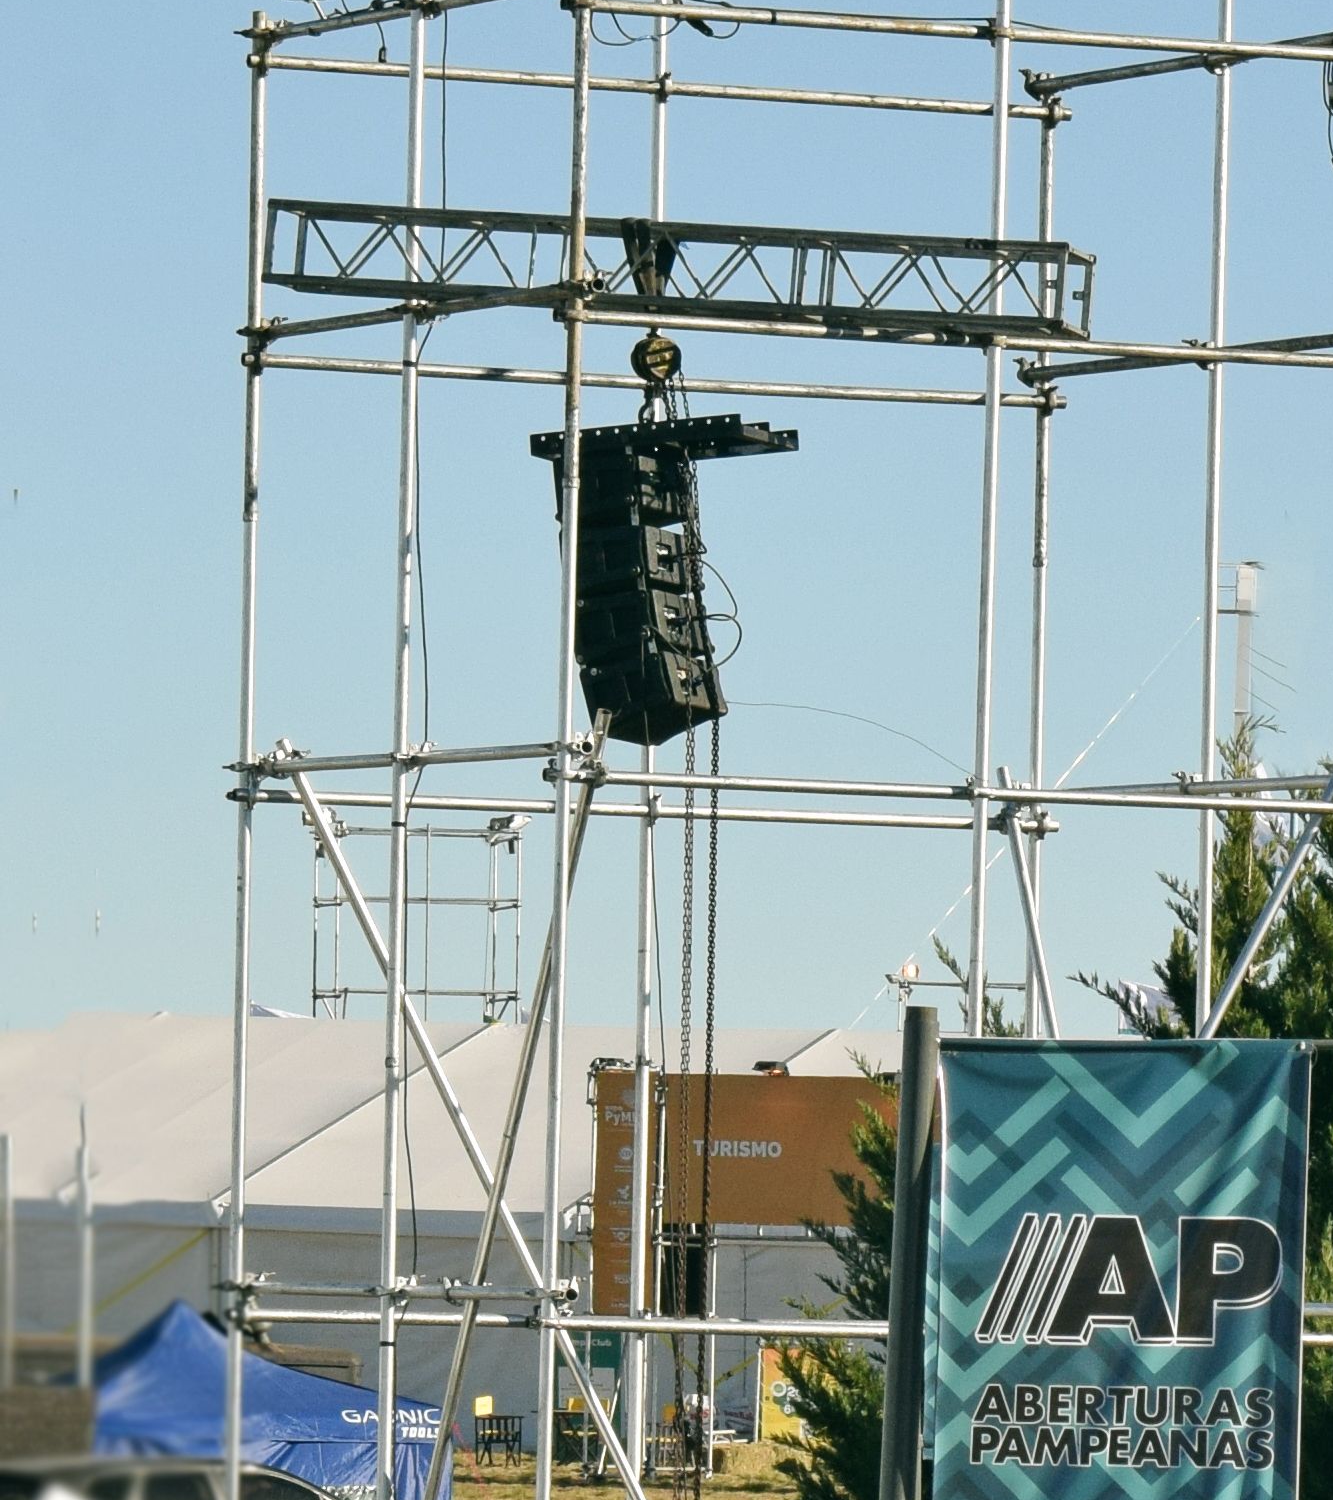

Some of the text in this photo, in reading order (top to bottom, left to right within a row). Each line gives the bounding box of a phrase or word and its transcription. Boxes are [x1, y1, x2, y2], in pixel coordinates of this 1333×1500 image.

[693, 1139, 783, 1158] TURISMO
[1044, 1214, 1284, 1347] AP
[341, 1408, 442, 1425] GANIC
[973, 1384, 1275, 1428] ABERTURAS
[970, 1426, 1275, 1470] PAMPEANAS
